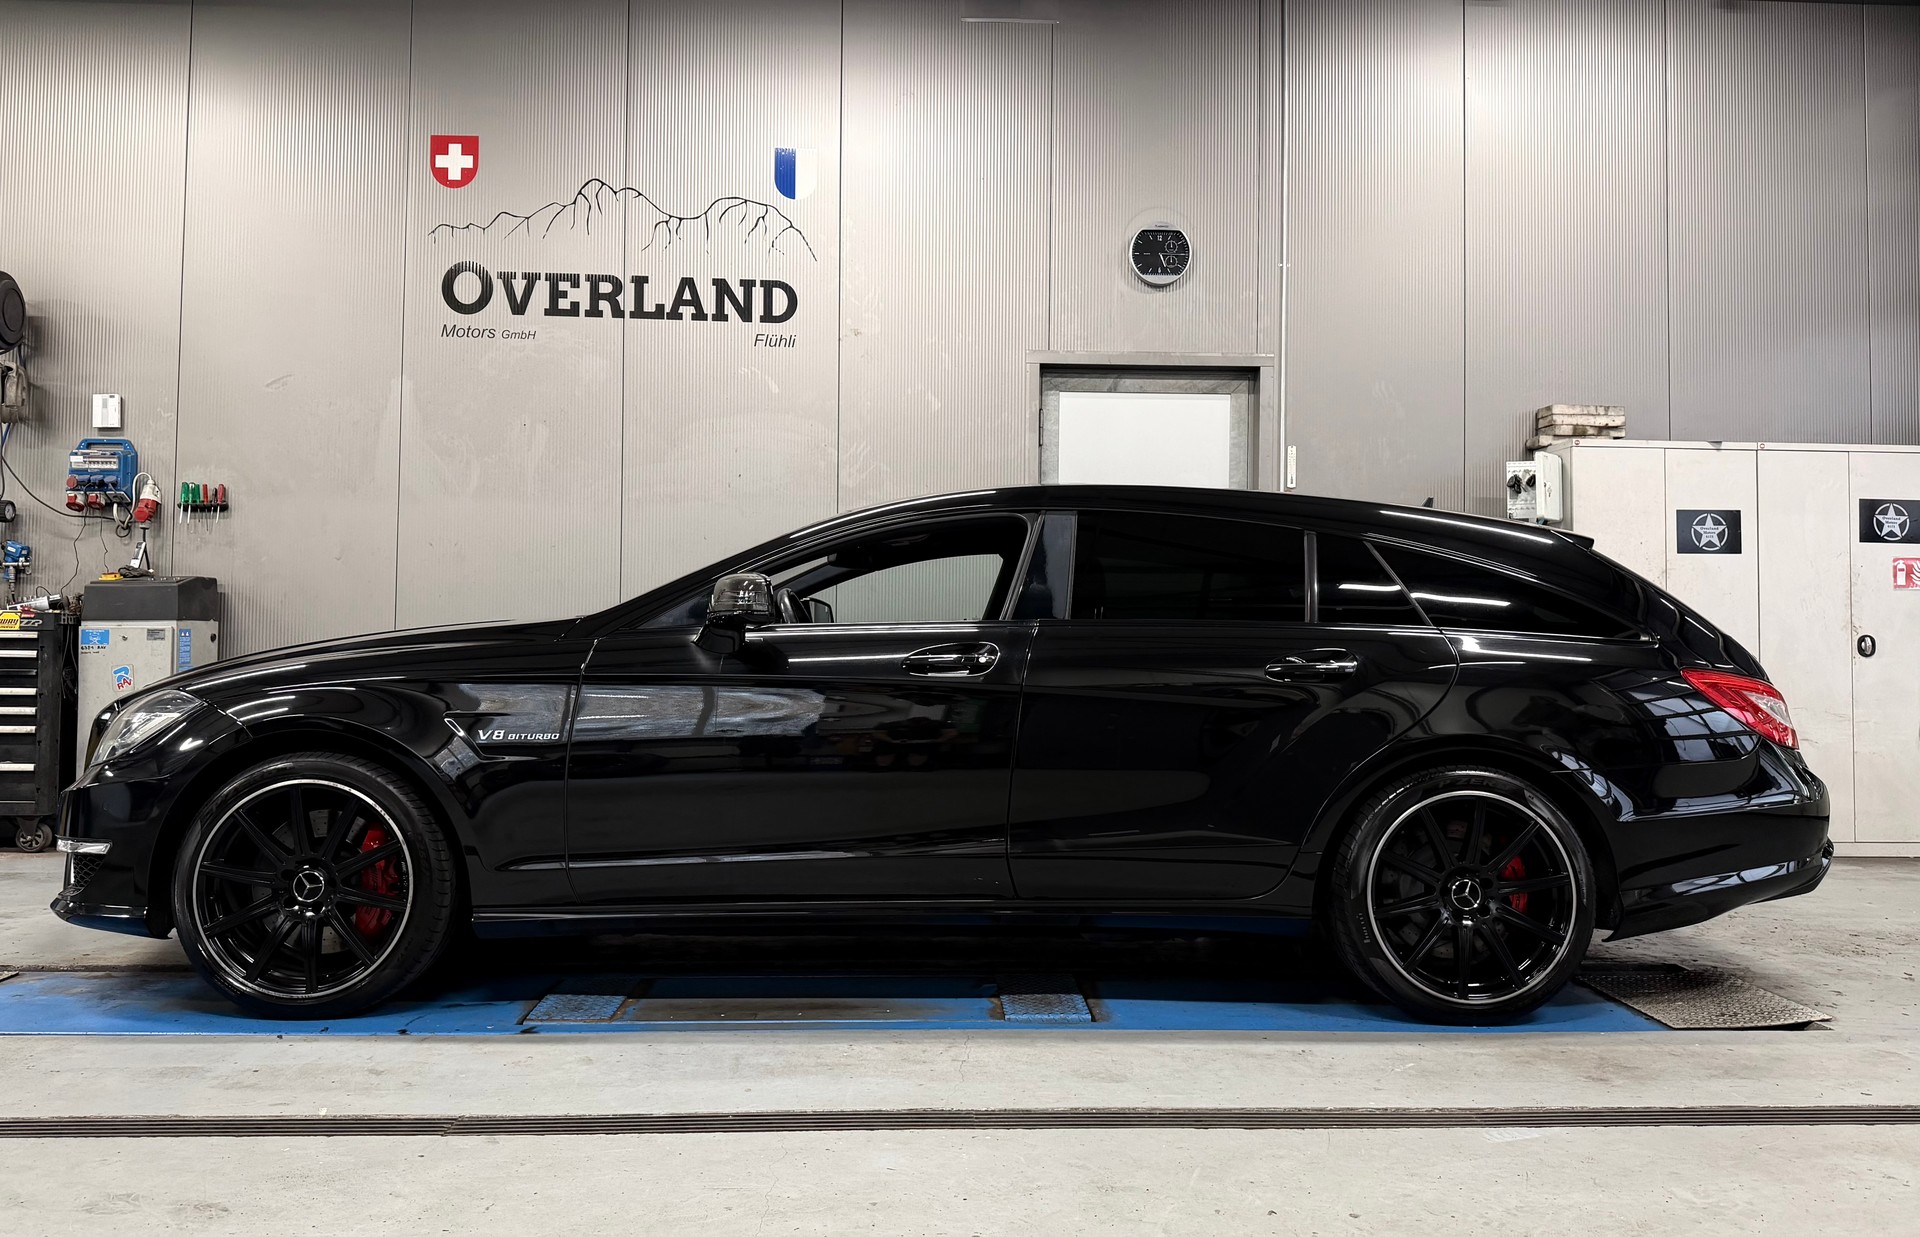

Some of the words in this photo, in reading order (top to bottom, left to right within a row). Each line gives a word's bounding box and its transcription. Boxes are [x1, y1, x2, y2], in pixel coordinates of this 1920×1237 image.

[441, 260, 798, 324] OVERLAND
[441, 324, 496, 339] Motors
[501, 329, 536, 340] GmbH
[754, 333, 797, 349] Flühli
[117, 678, 132, 690] RAV
[478, 730, 505, 740] V8
